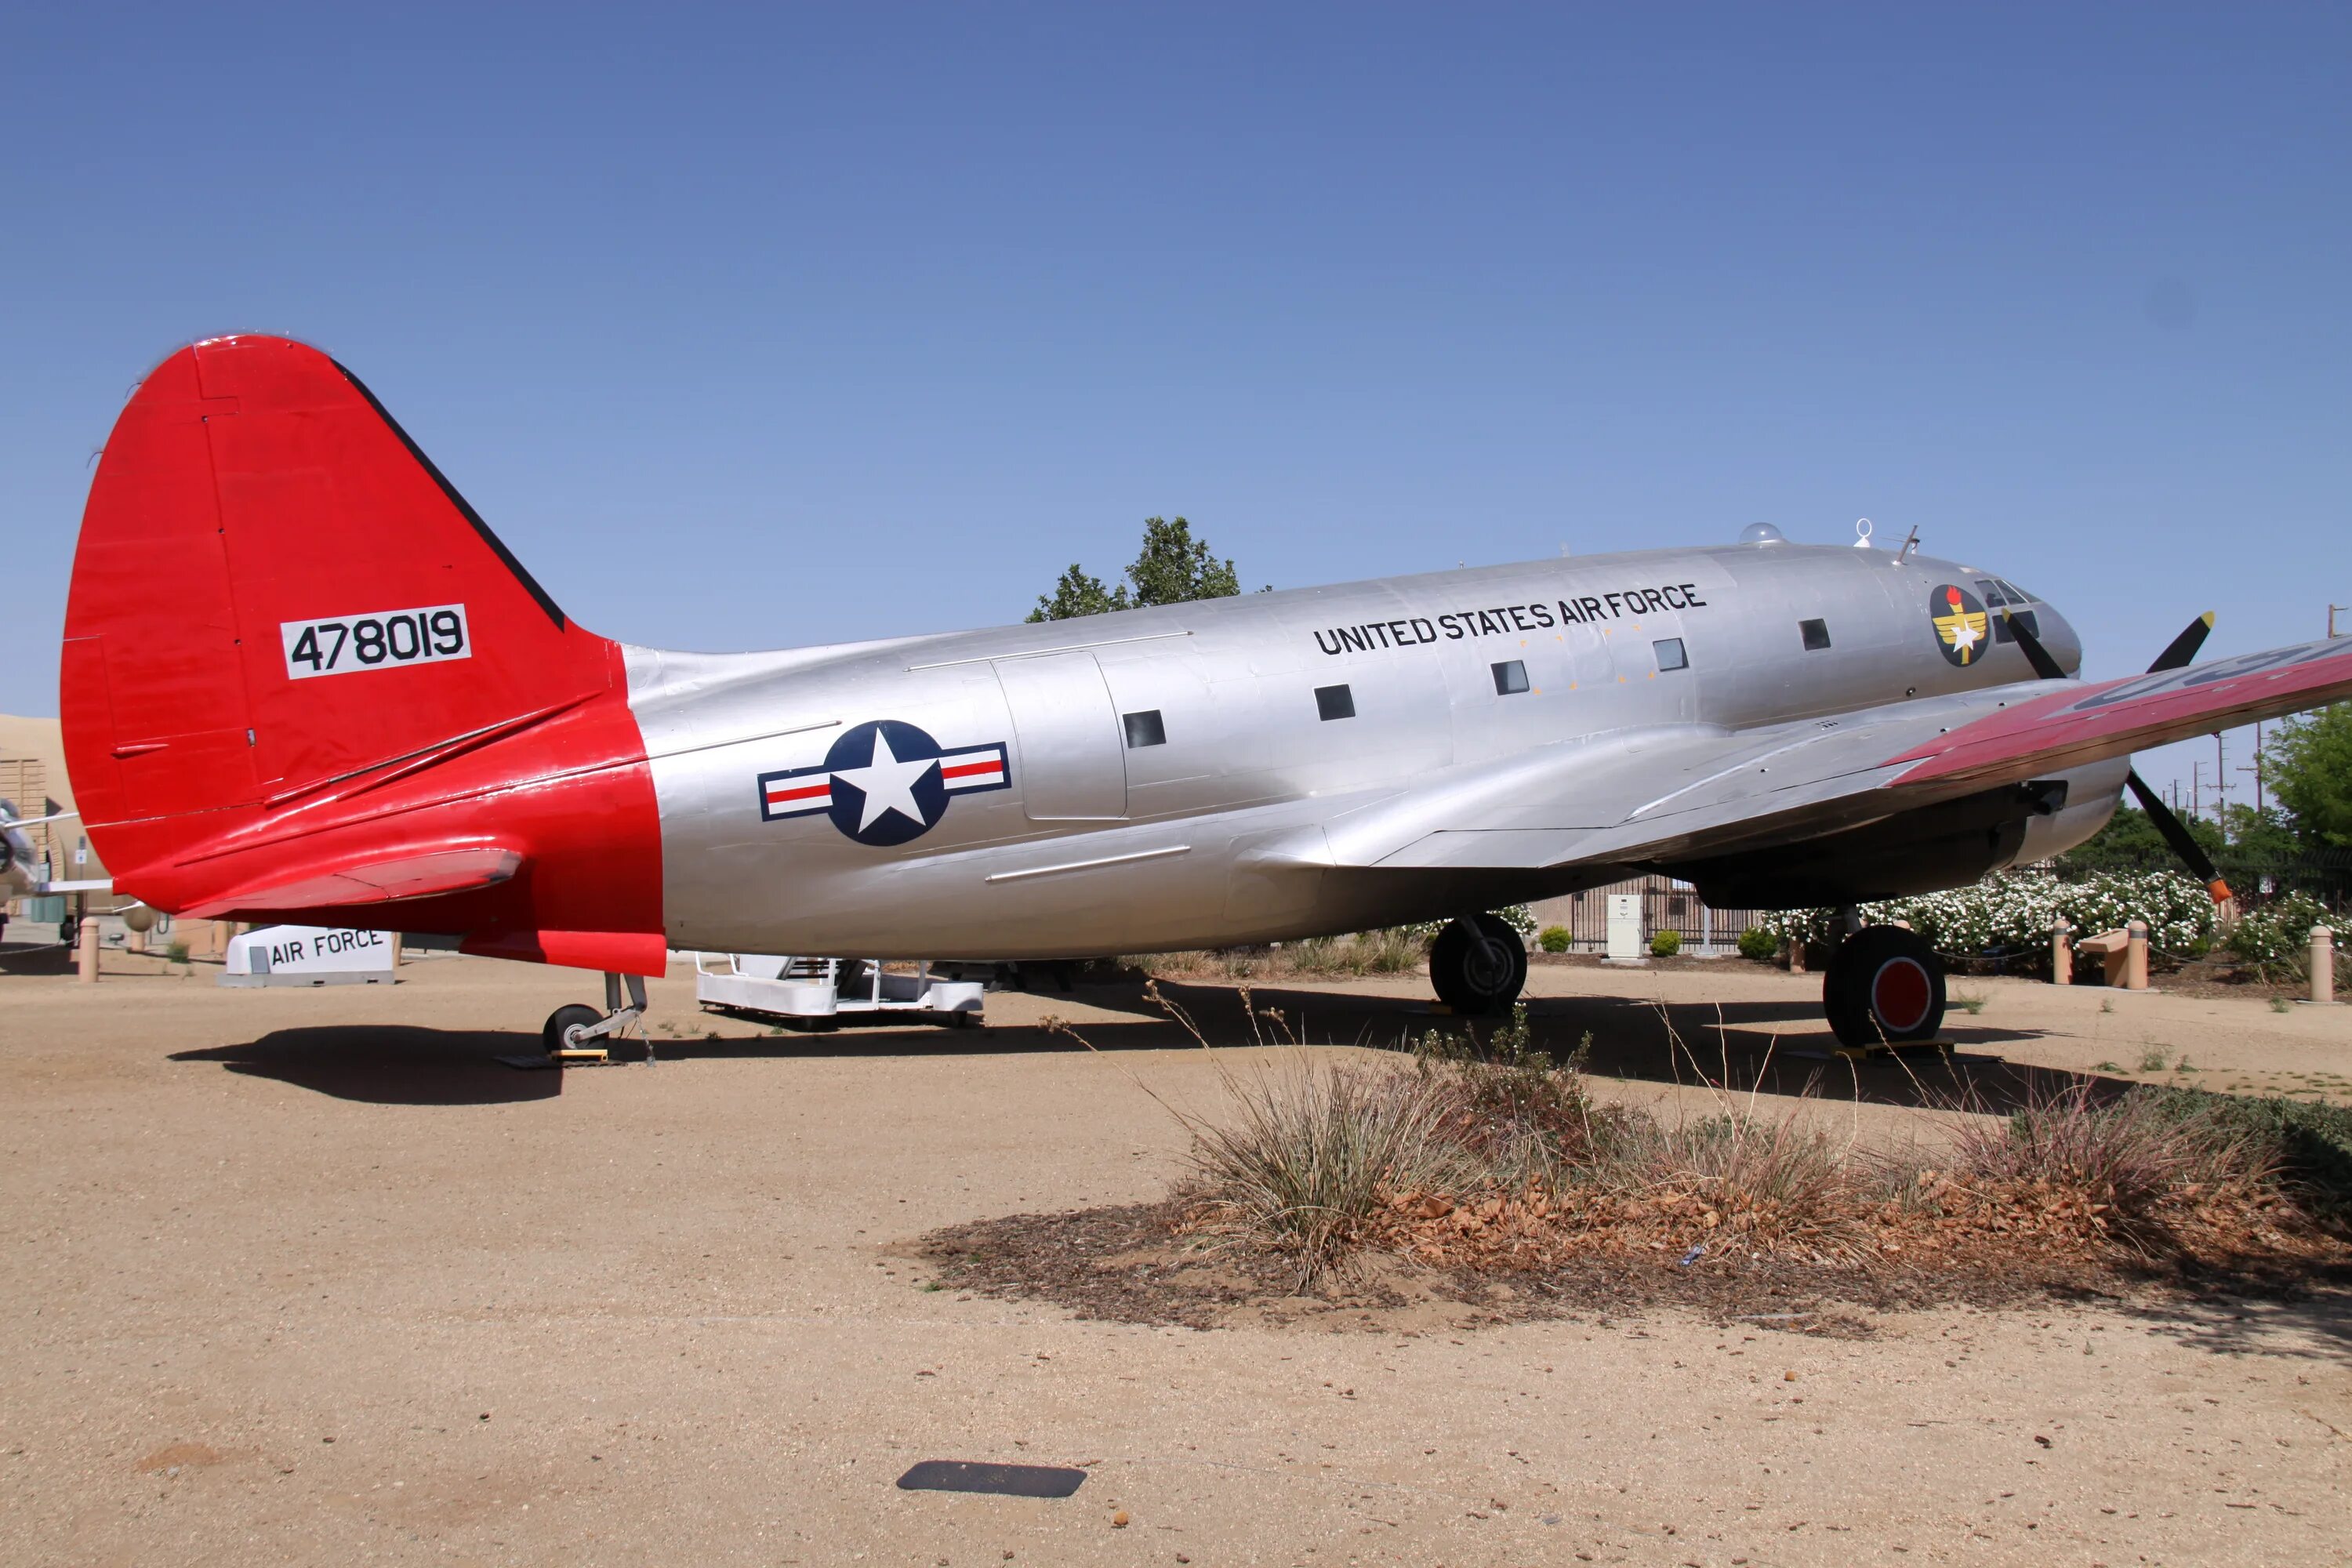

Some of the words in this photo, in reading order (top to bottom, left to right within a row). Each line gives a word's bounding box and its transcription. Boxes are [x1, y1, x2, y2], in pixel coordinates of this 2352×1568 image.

[292, 610, 464, 671] 478019
[1314, 618, 1438, 656] UNITED
[1438, 604, 1555, 640] STATES
[1557, 597, 1609, 625] AIR
[1602, 583, 1707, 618] FORCE
[272, 942, 304, 965] AIR
[314, 930, 383, 956] FORCE
